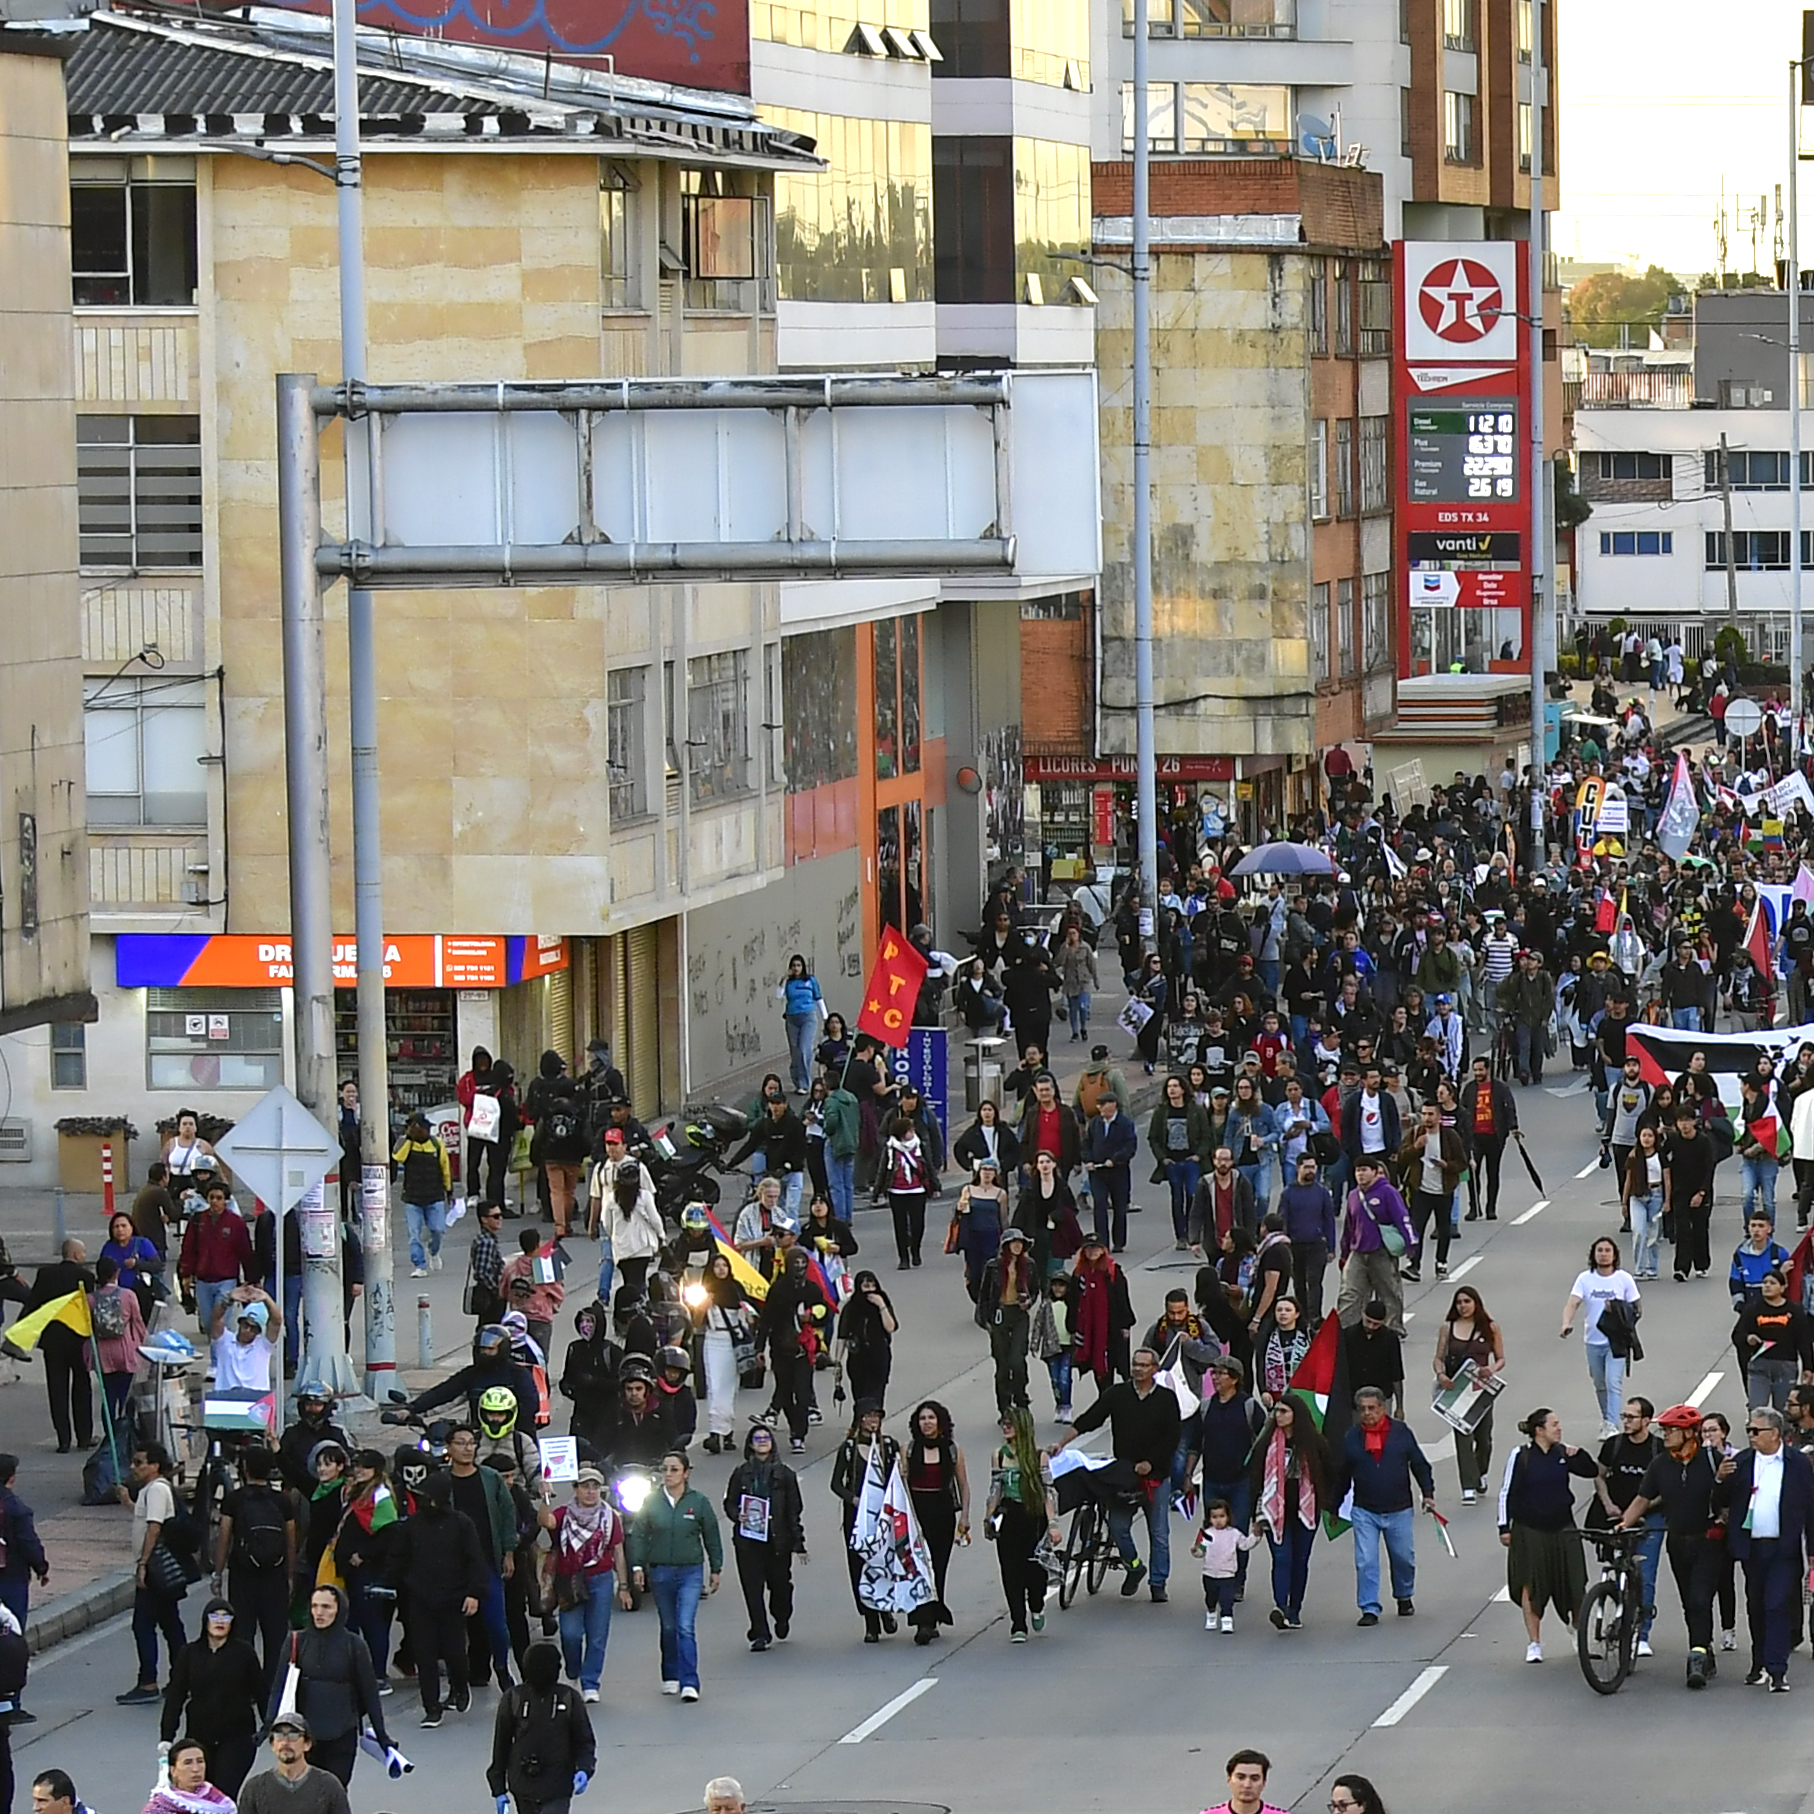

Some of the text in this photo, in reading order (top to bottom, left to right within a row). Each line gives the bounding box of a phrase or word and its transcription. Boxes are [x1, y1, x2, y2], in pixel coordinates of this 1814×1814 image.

[1438, 513, 1460, 523] EDS
[1462, 513, 1473, 523] TX
[1436, 537, 1476, 551] vanti
[1039, 756, 1097, 774] LICORES
[1162, 756, 1180, 773] 26
[1579, 781, 1598, 851] CUT
[258, 944, 403, 962] DRUEA
